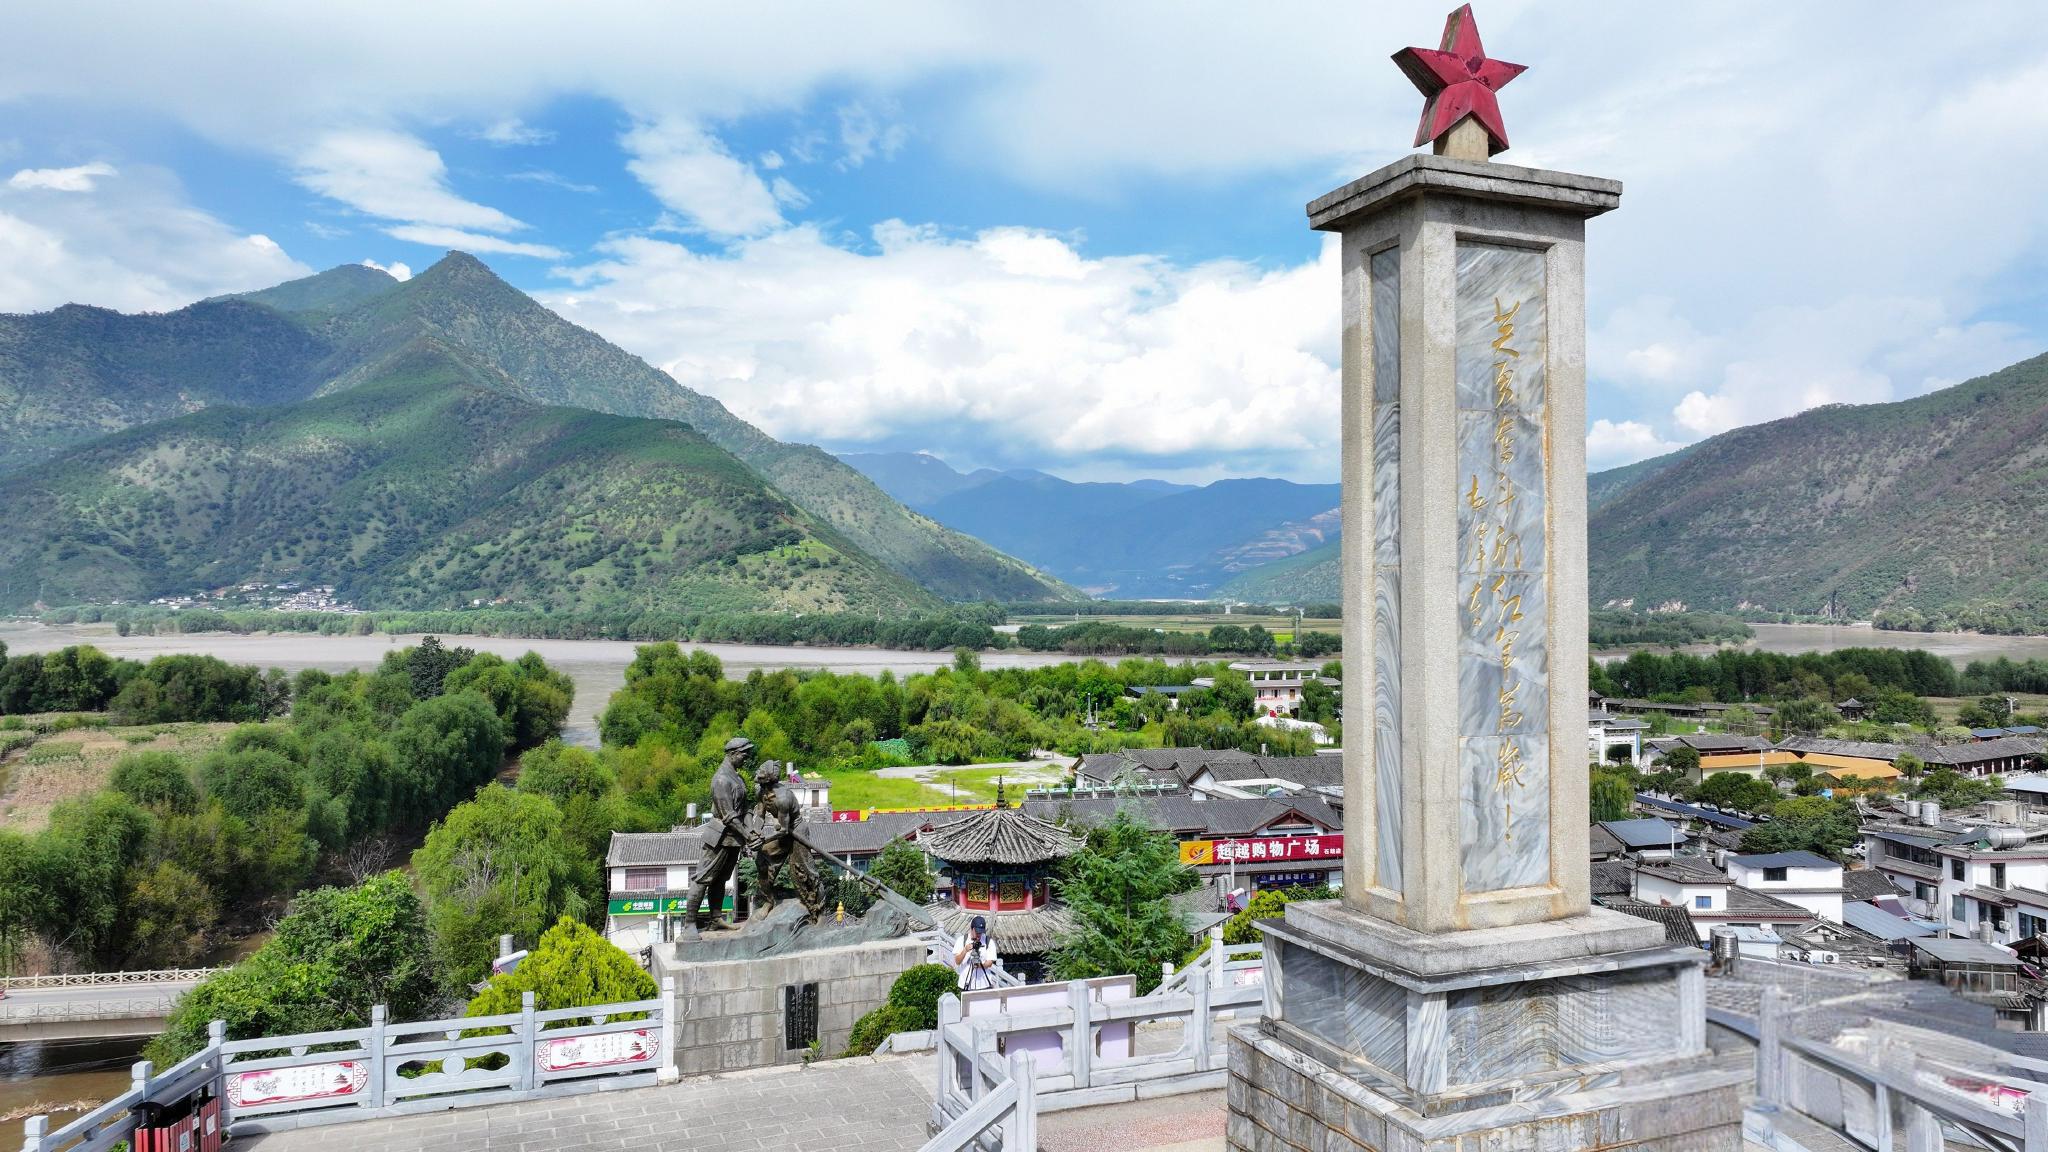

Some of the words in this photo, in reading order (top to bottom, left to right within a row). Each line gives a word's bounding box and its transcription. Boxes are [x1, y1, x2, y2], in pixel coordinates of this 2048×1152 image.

[1217, 839, 1320, 860] 超越购物广场
